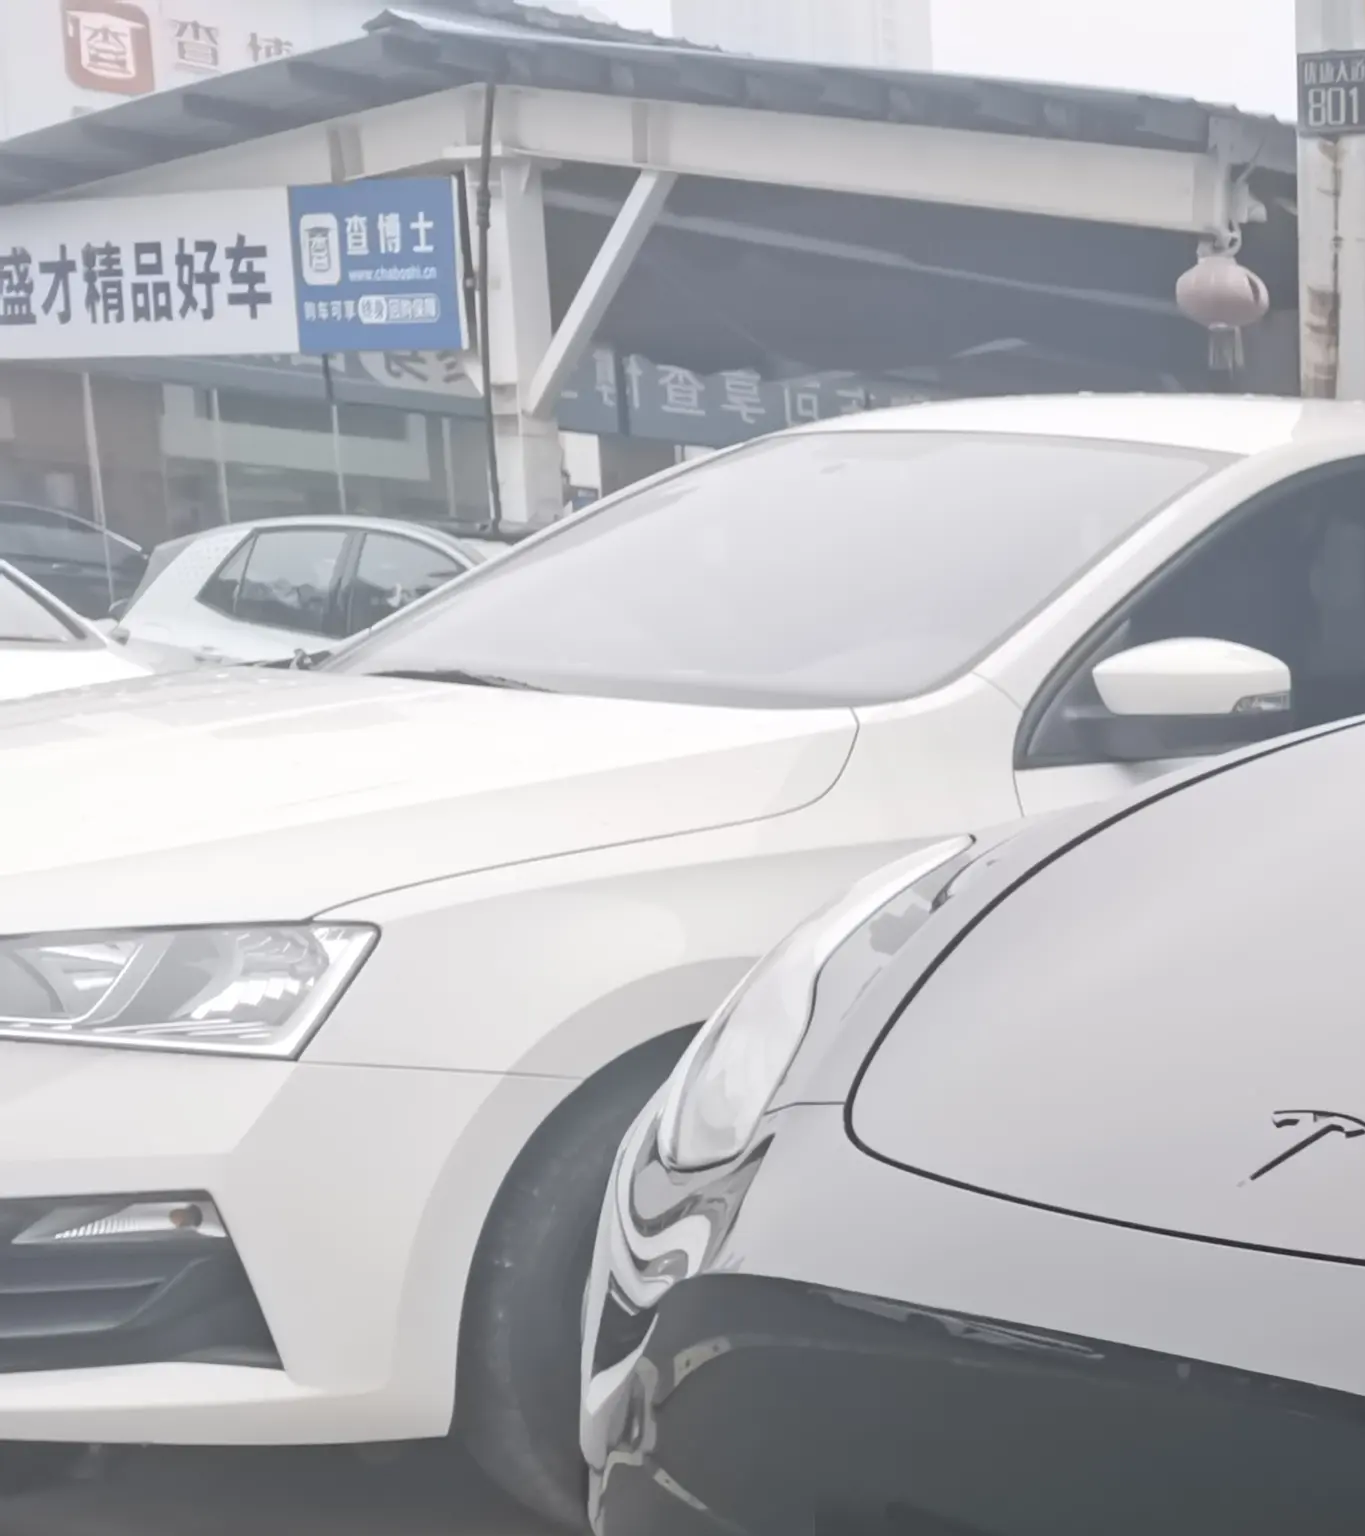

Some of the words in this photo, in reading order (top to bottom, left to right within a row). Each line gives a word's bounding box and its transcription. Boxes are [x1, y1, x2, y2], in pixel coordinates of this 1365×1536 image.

[1308, 86, 1360, 127] 801
[345, 211, 435, 256] 查博士
[0, 233, 272, 325] 盛才精品好车
